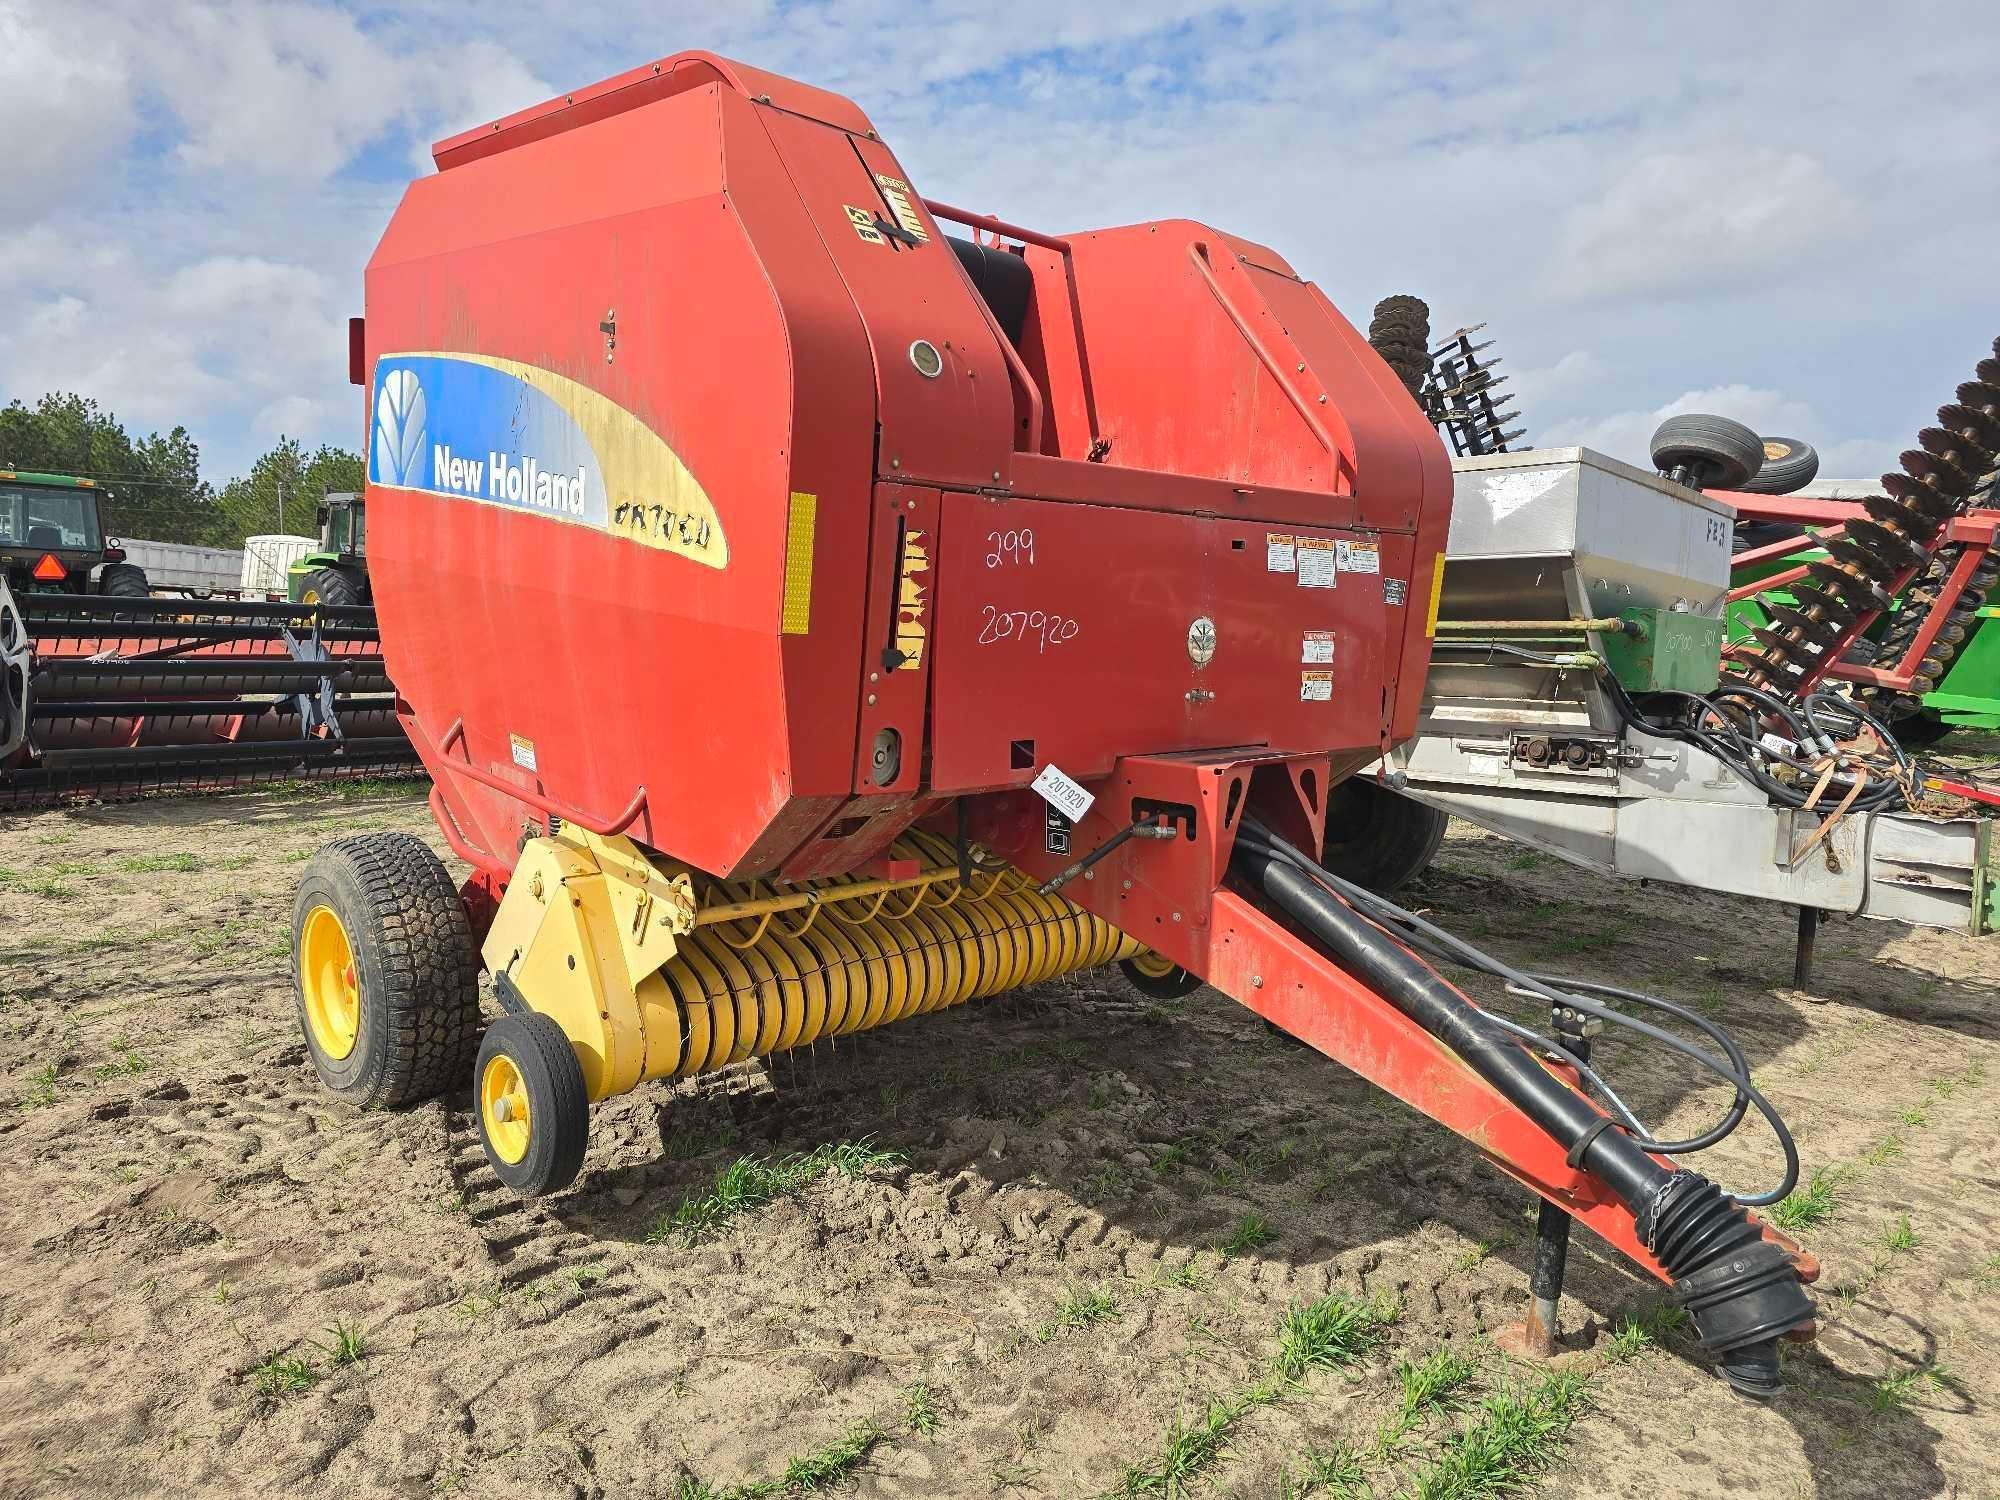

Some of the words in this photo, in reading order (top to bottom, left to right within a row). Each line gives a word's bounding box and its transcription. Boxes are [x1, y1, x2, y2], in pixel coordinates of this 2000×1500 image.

[434, 444, 483, 493] New
[489, 451, 585, 516] Holland
[986, 528, 1034, 568] 299
[978, 605, 1079, 654] 207920
[1048, 777, 1085, 809] 207920
